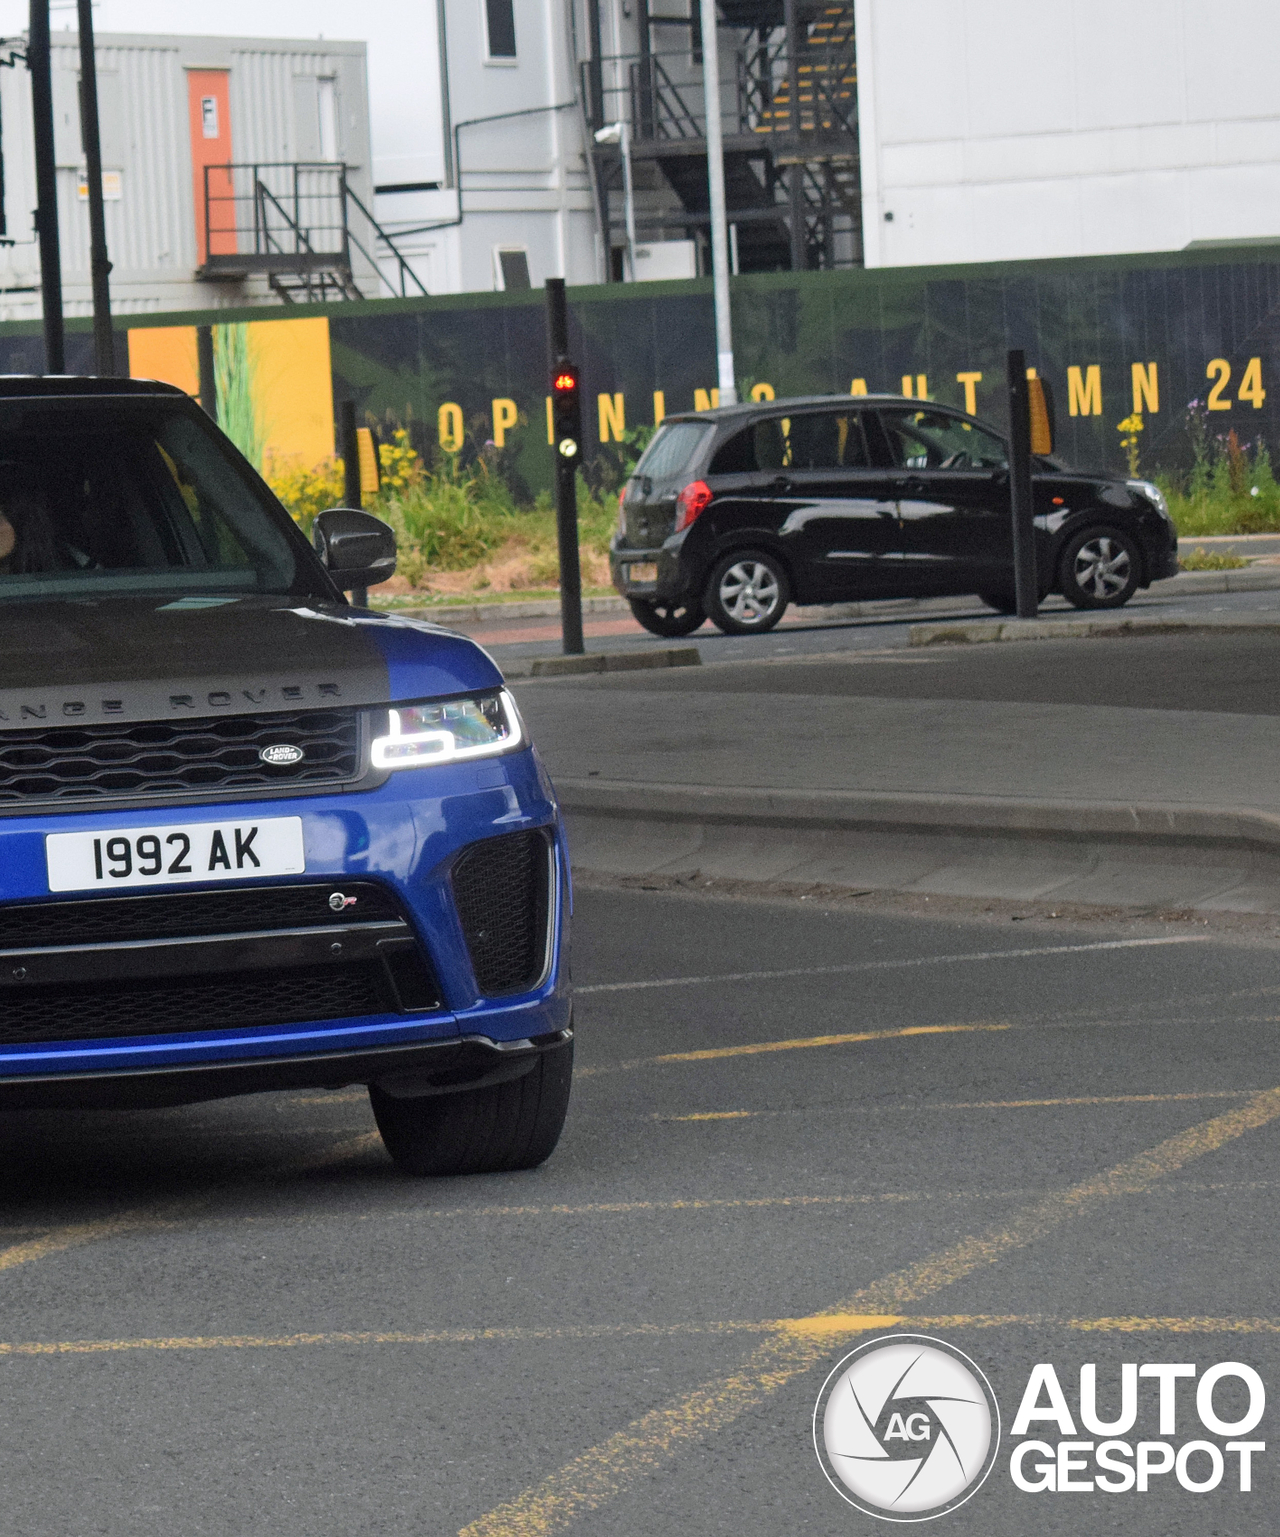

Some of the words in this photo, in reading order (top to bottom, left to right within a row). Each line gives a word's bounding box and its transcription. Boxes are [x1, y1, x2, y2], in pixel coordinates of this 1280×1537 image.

[851, 362, 1159, 417] TMN
[1206, 357, 1266, 411] 24
[169, 683, 341, 710] ROVER
[270, 747, 291, 755] LAND
[272, 752, 298, 761] ROVER
[93, 832, 192, 880] 1992
[208, 826, 261, 871] AK
